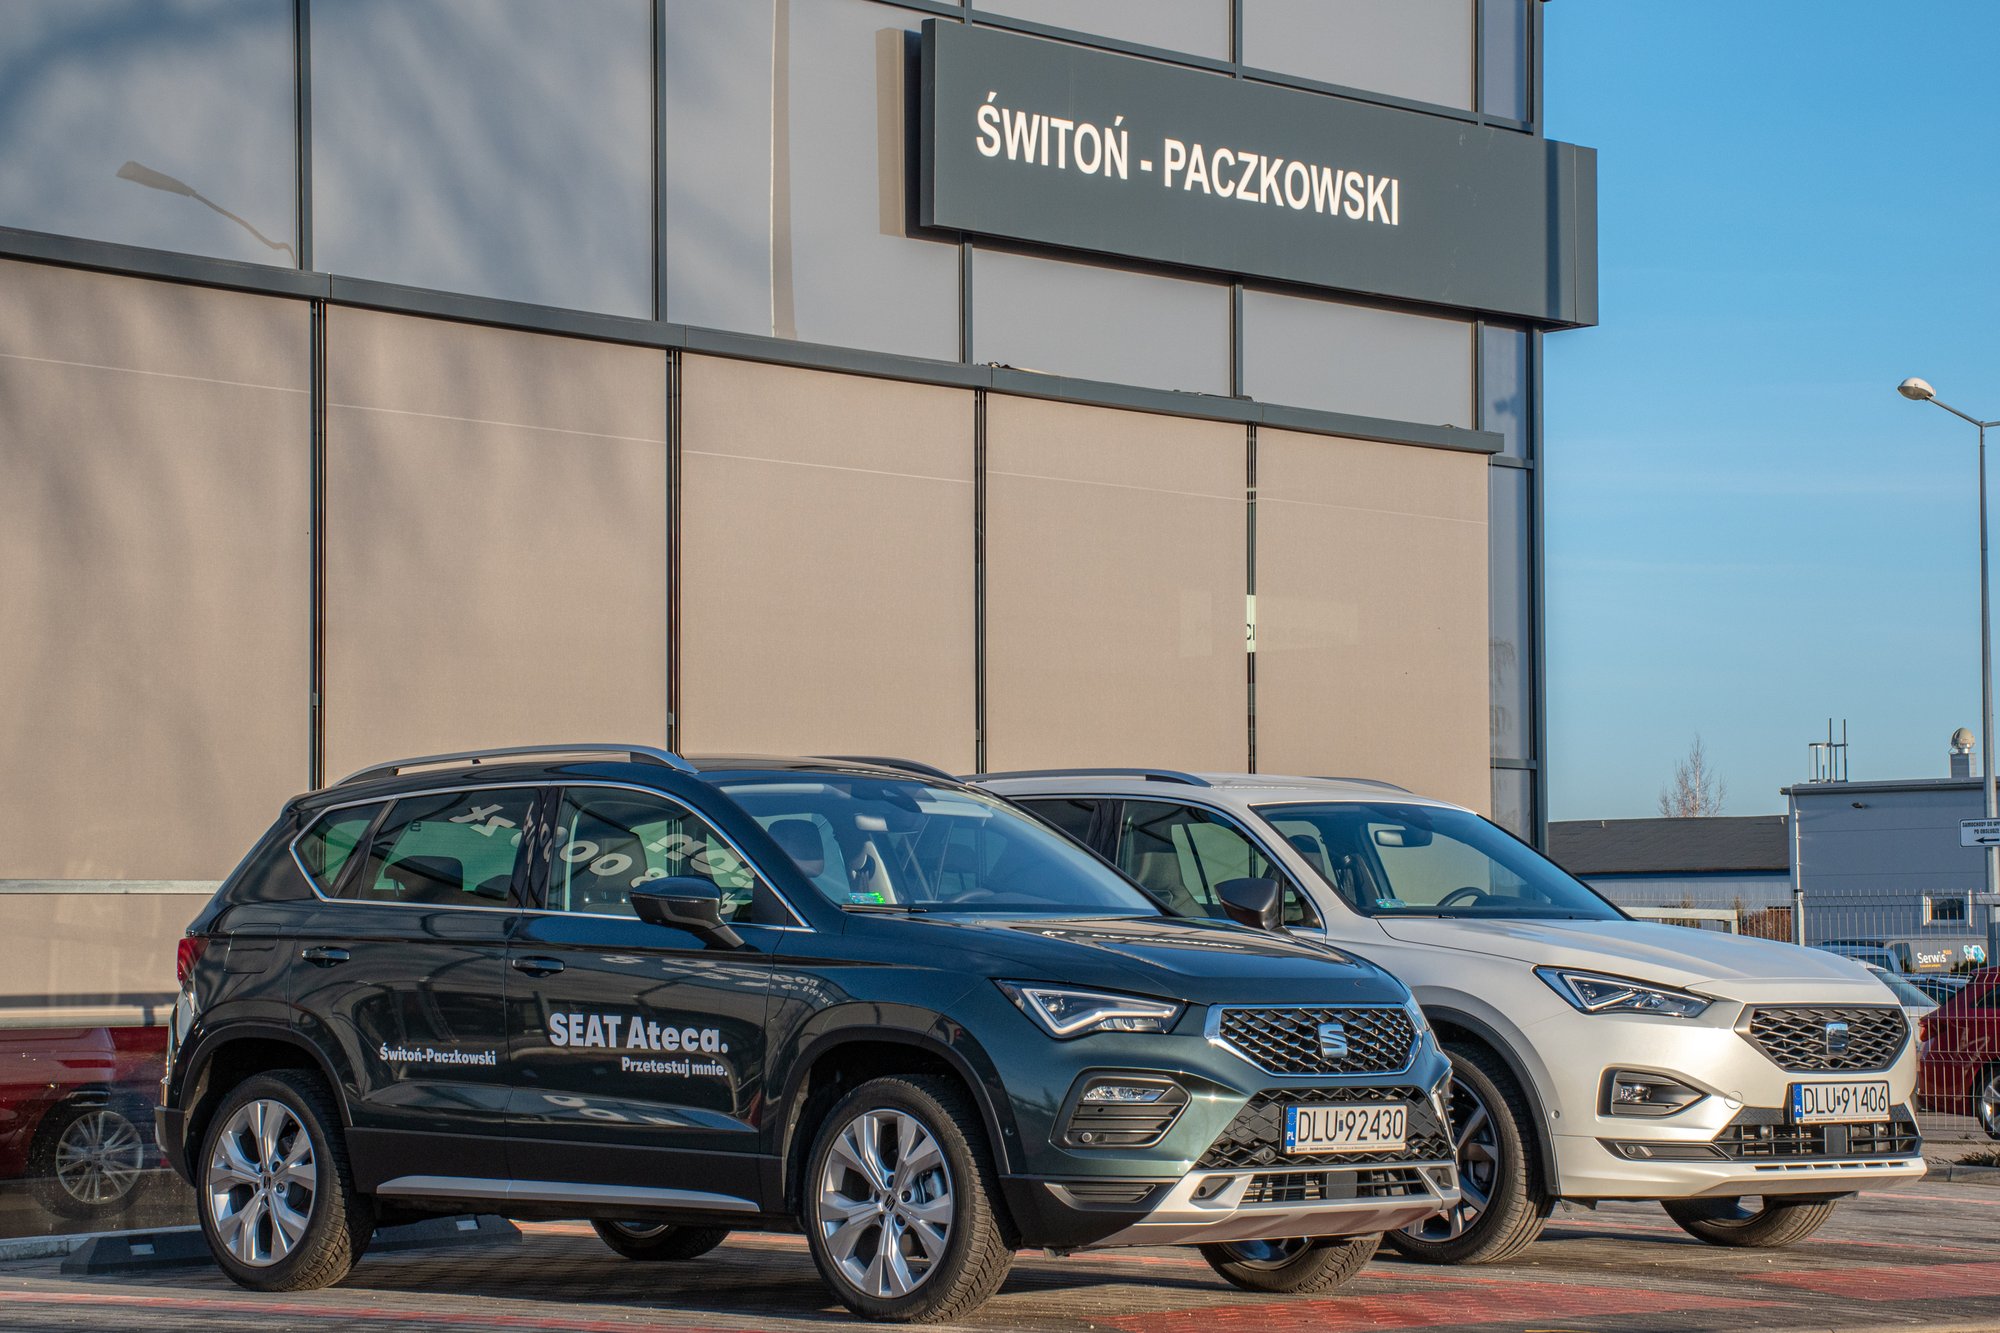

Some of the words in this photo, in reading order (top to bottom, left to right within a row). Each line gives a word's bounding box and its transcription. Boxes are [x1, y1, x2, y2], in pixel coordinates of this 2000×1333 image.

[976, 91, 1128, 180] ŚWITOŃ
[1164, 138, 1400, 226] PACZKOWSKI
[1917, 951, 1947, 963] Serwis
[549, 1012, 622, 1048] SEAT
[626, 1015, 729, 1053] Ateca.
[379, 1041, 496, 1065] Świtoń-Paczkowski
[621, 1056, 690, 1079] Przetestuj
[692, 1061, 728, 1077] mnie.
[1803, 1087, 1836, 1114] DLU
[1841, 1086, 1886, 1113] 91406
[1286, 1131, 1295, 1140] PL
[1298, 1110, 1338, 1142] DLU
[1345, 1108, 1404, 1141] 92430
